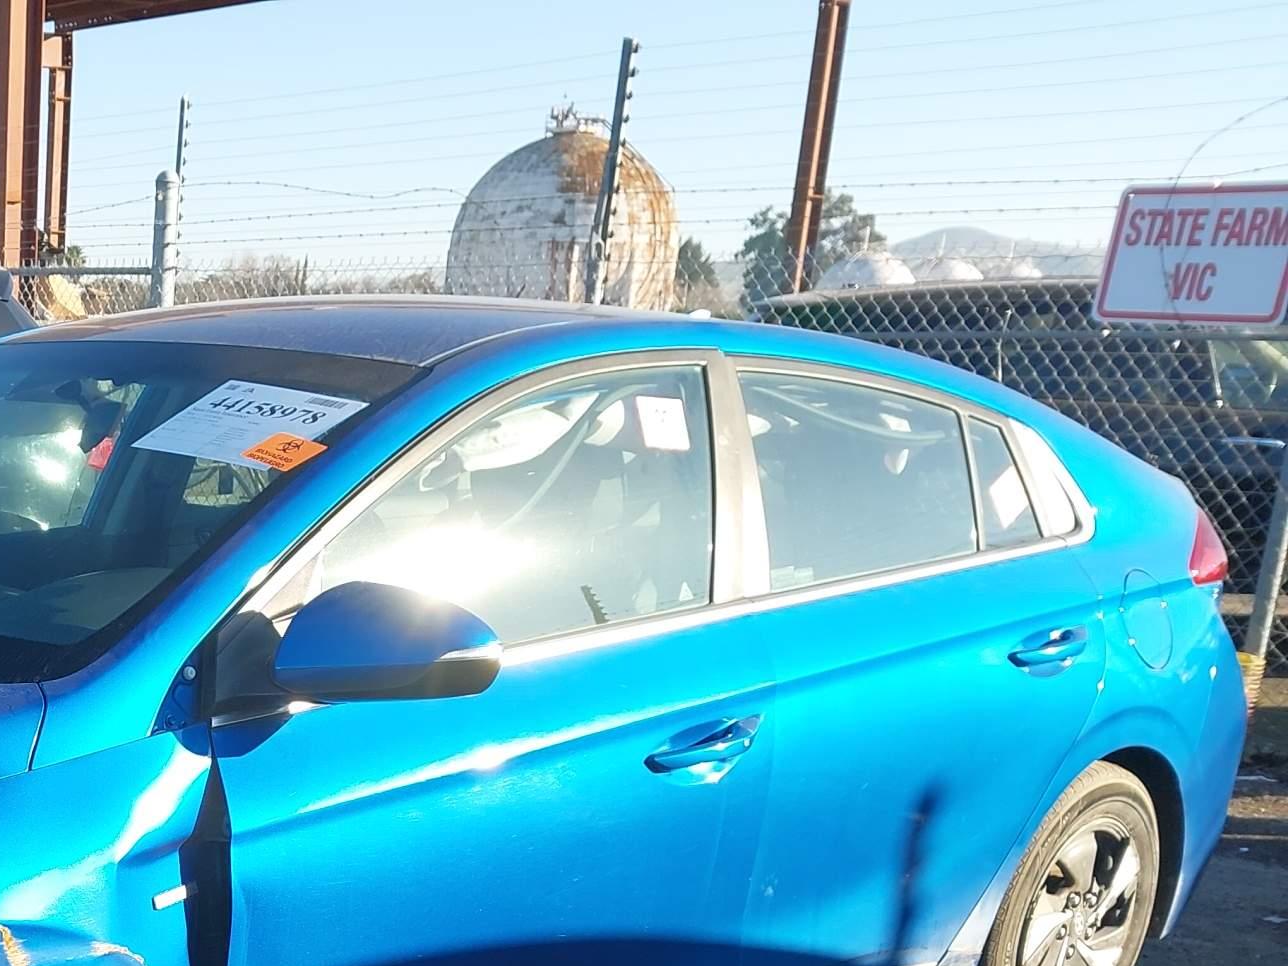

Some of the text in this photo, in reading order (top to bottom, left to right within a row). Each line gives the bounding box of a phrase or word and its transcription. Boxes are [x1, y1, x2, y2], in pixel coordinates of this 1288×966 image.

[1125, 207, 1288, 247] STATE FARM
[1170, 262, 1217, 301] VIC
[209, 397, 327, 424] 44158978
